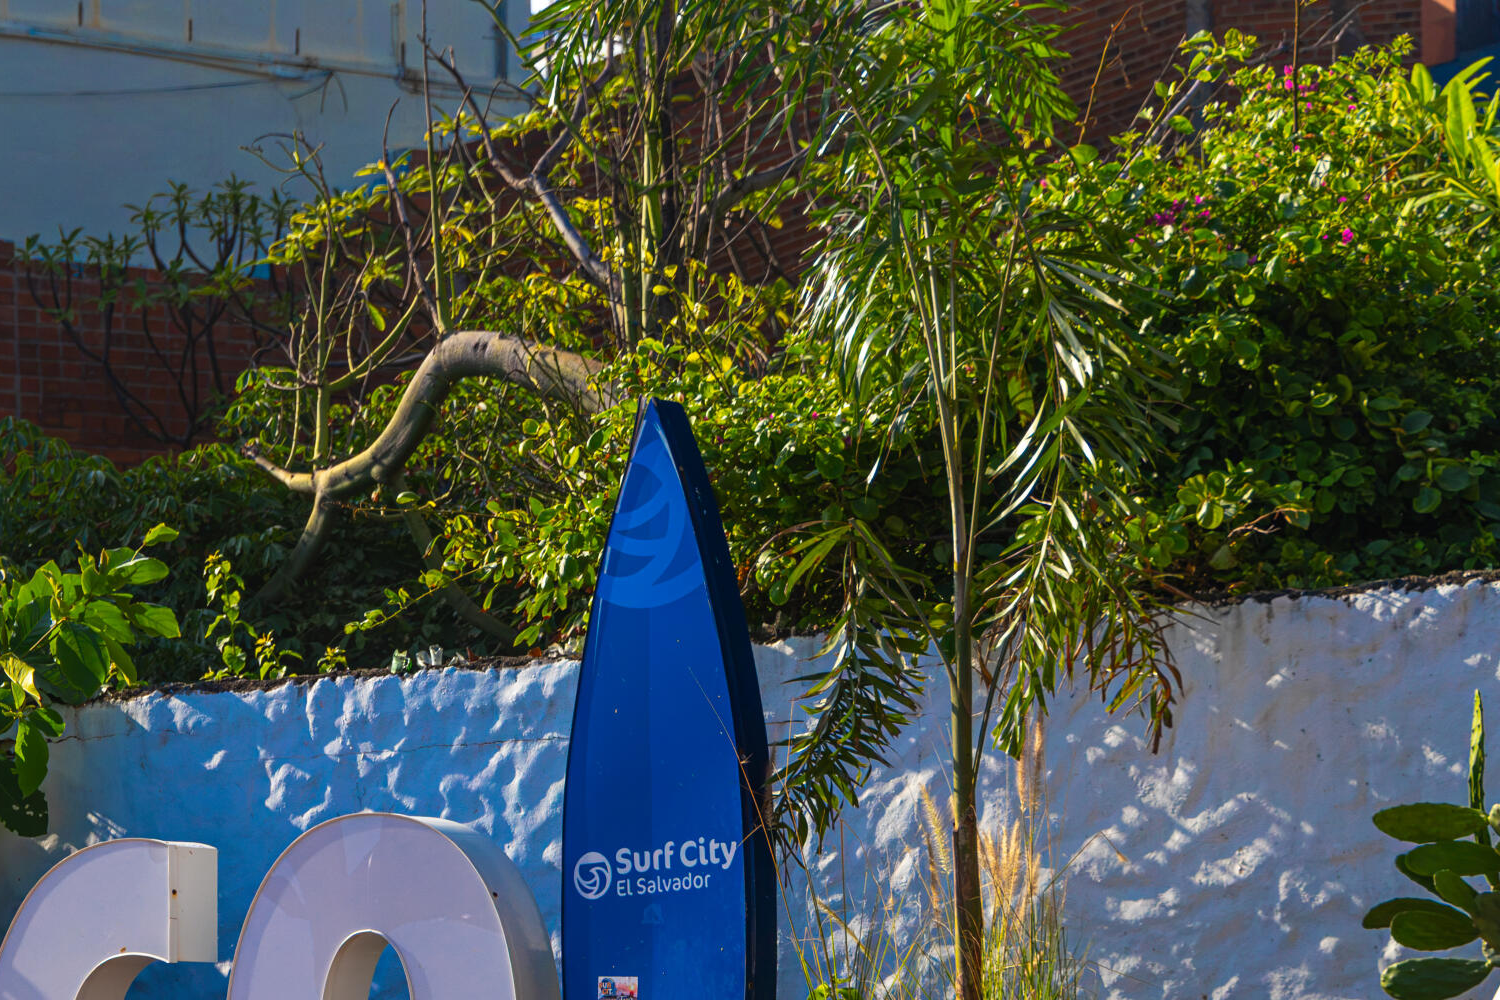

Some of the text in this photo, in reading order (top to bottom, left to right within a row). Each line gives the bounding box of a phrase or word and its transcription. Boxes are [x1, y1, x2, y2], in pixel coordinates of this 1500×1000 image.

[615, 836, 738, 875] Surf City
[616, 872, 711, 897] El Salvador
